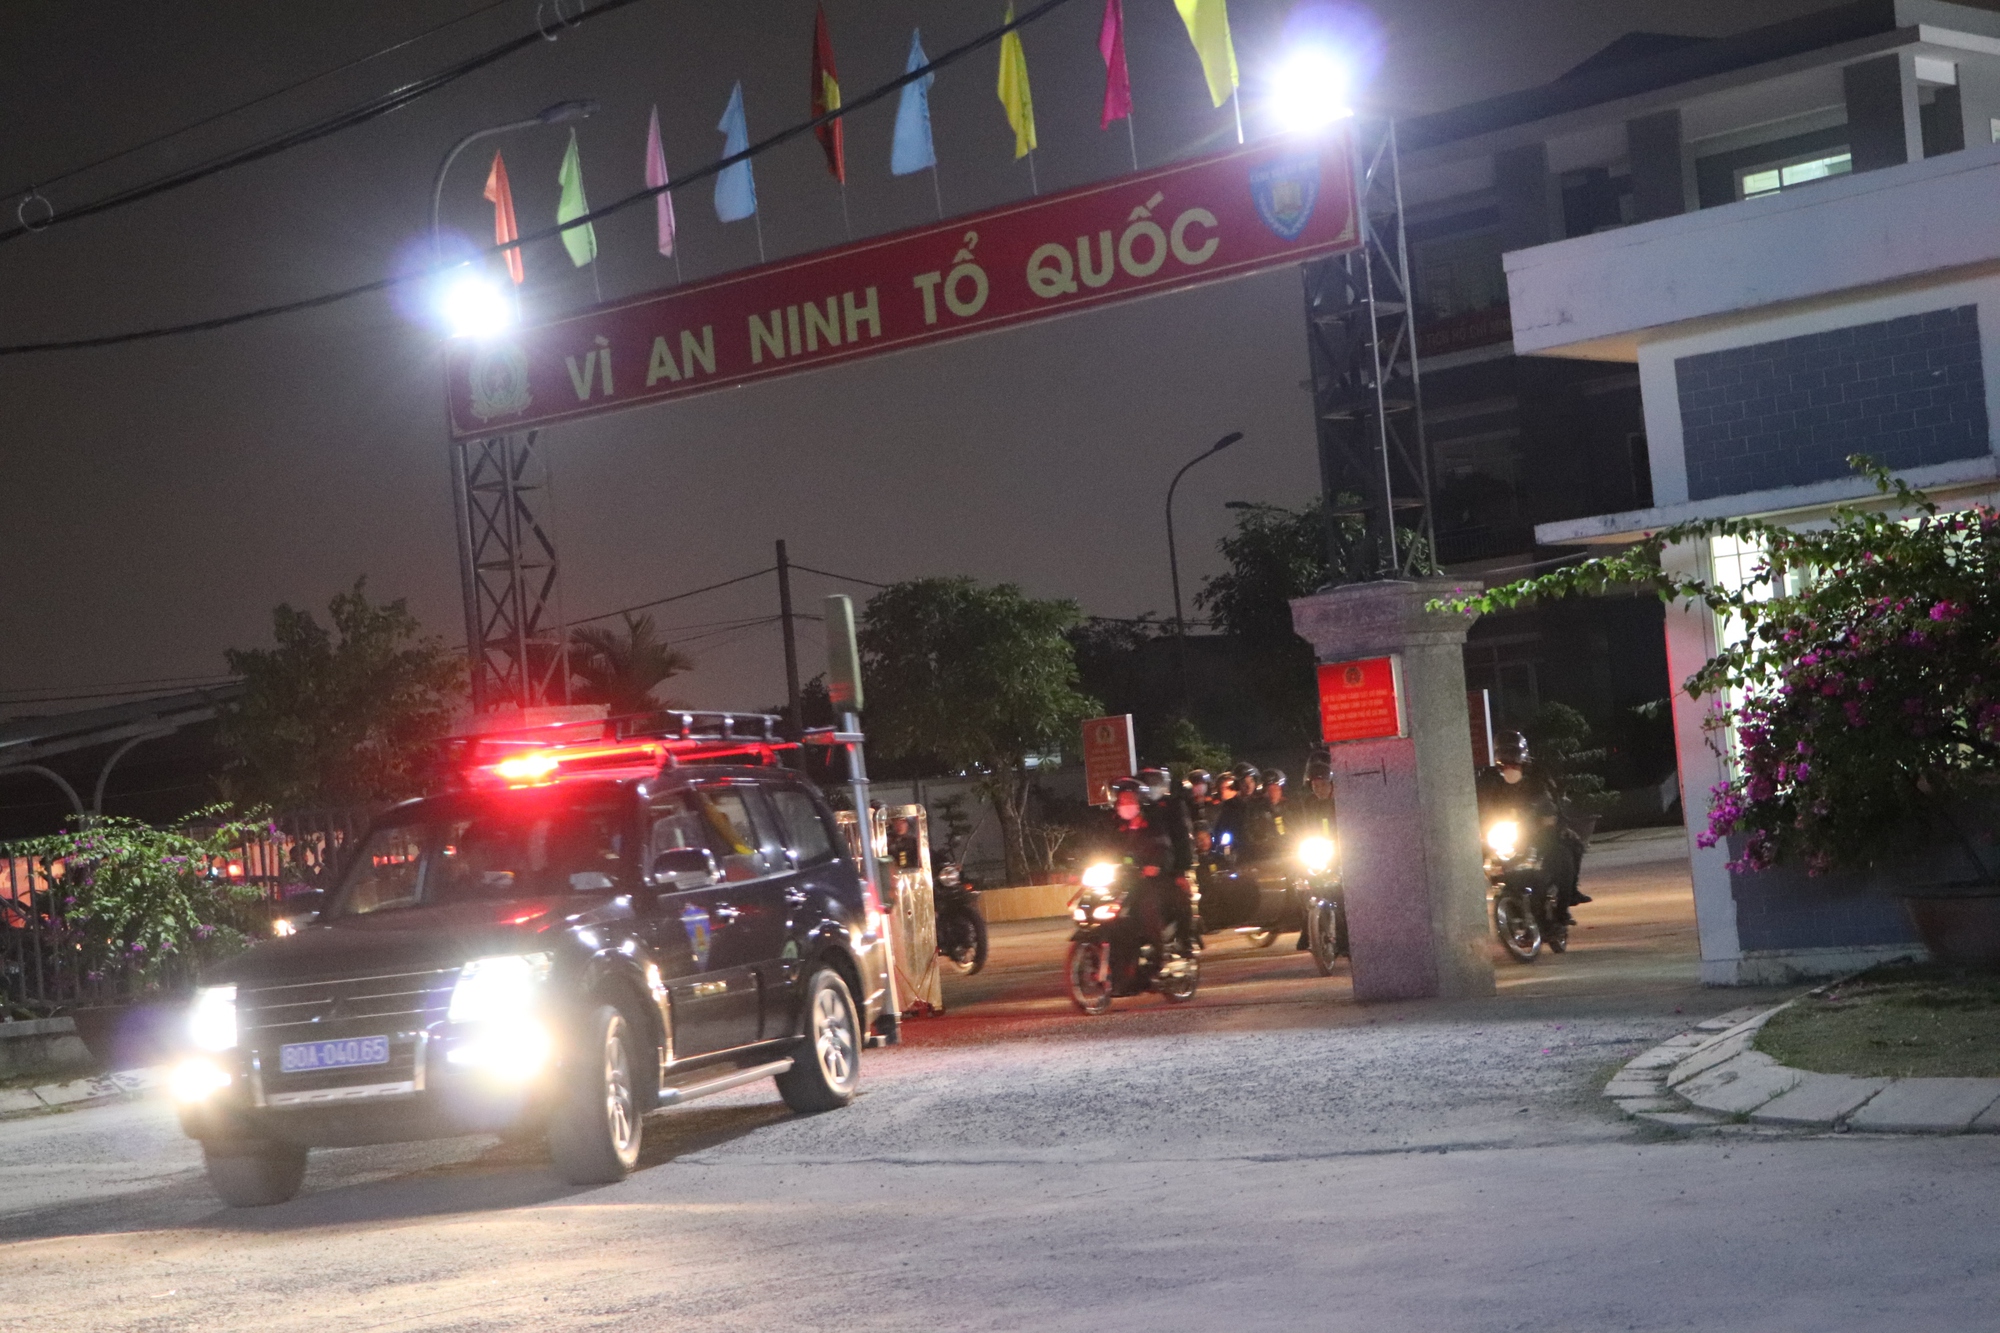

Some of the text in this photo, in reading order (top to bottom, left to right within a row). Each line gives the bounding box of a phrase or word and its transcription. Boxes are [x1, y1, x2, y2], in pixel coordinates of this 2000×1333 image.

[565, 334, 614, 401] VÌ
[646, 325, 716, 387] AN
[748, 286, 882, 364] NINH
[913, 231, 989, 325] TỔ
[1026, 191, 1220, 299] QUỐC
